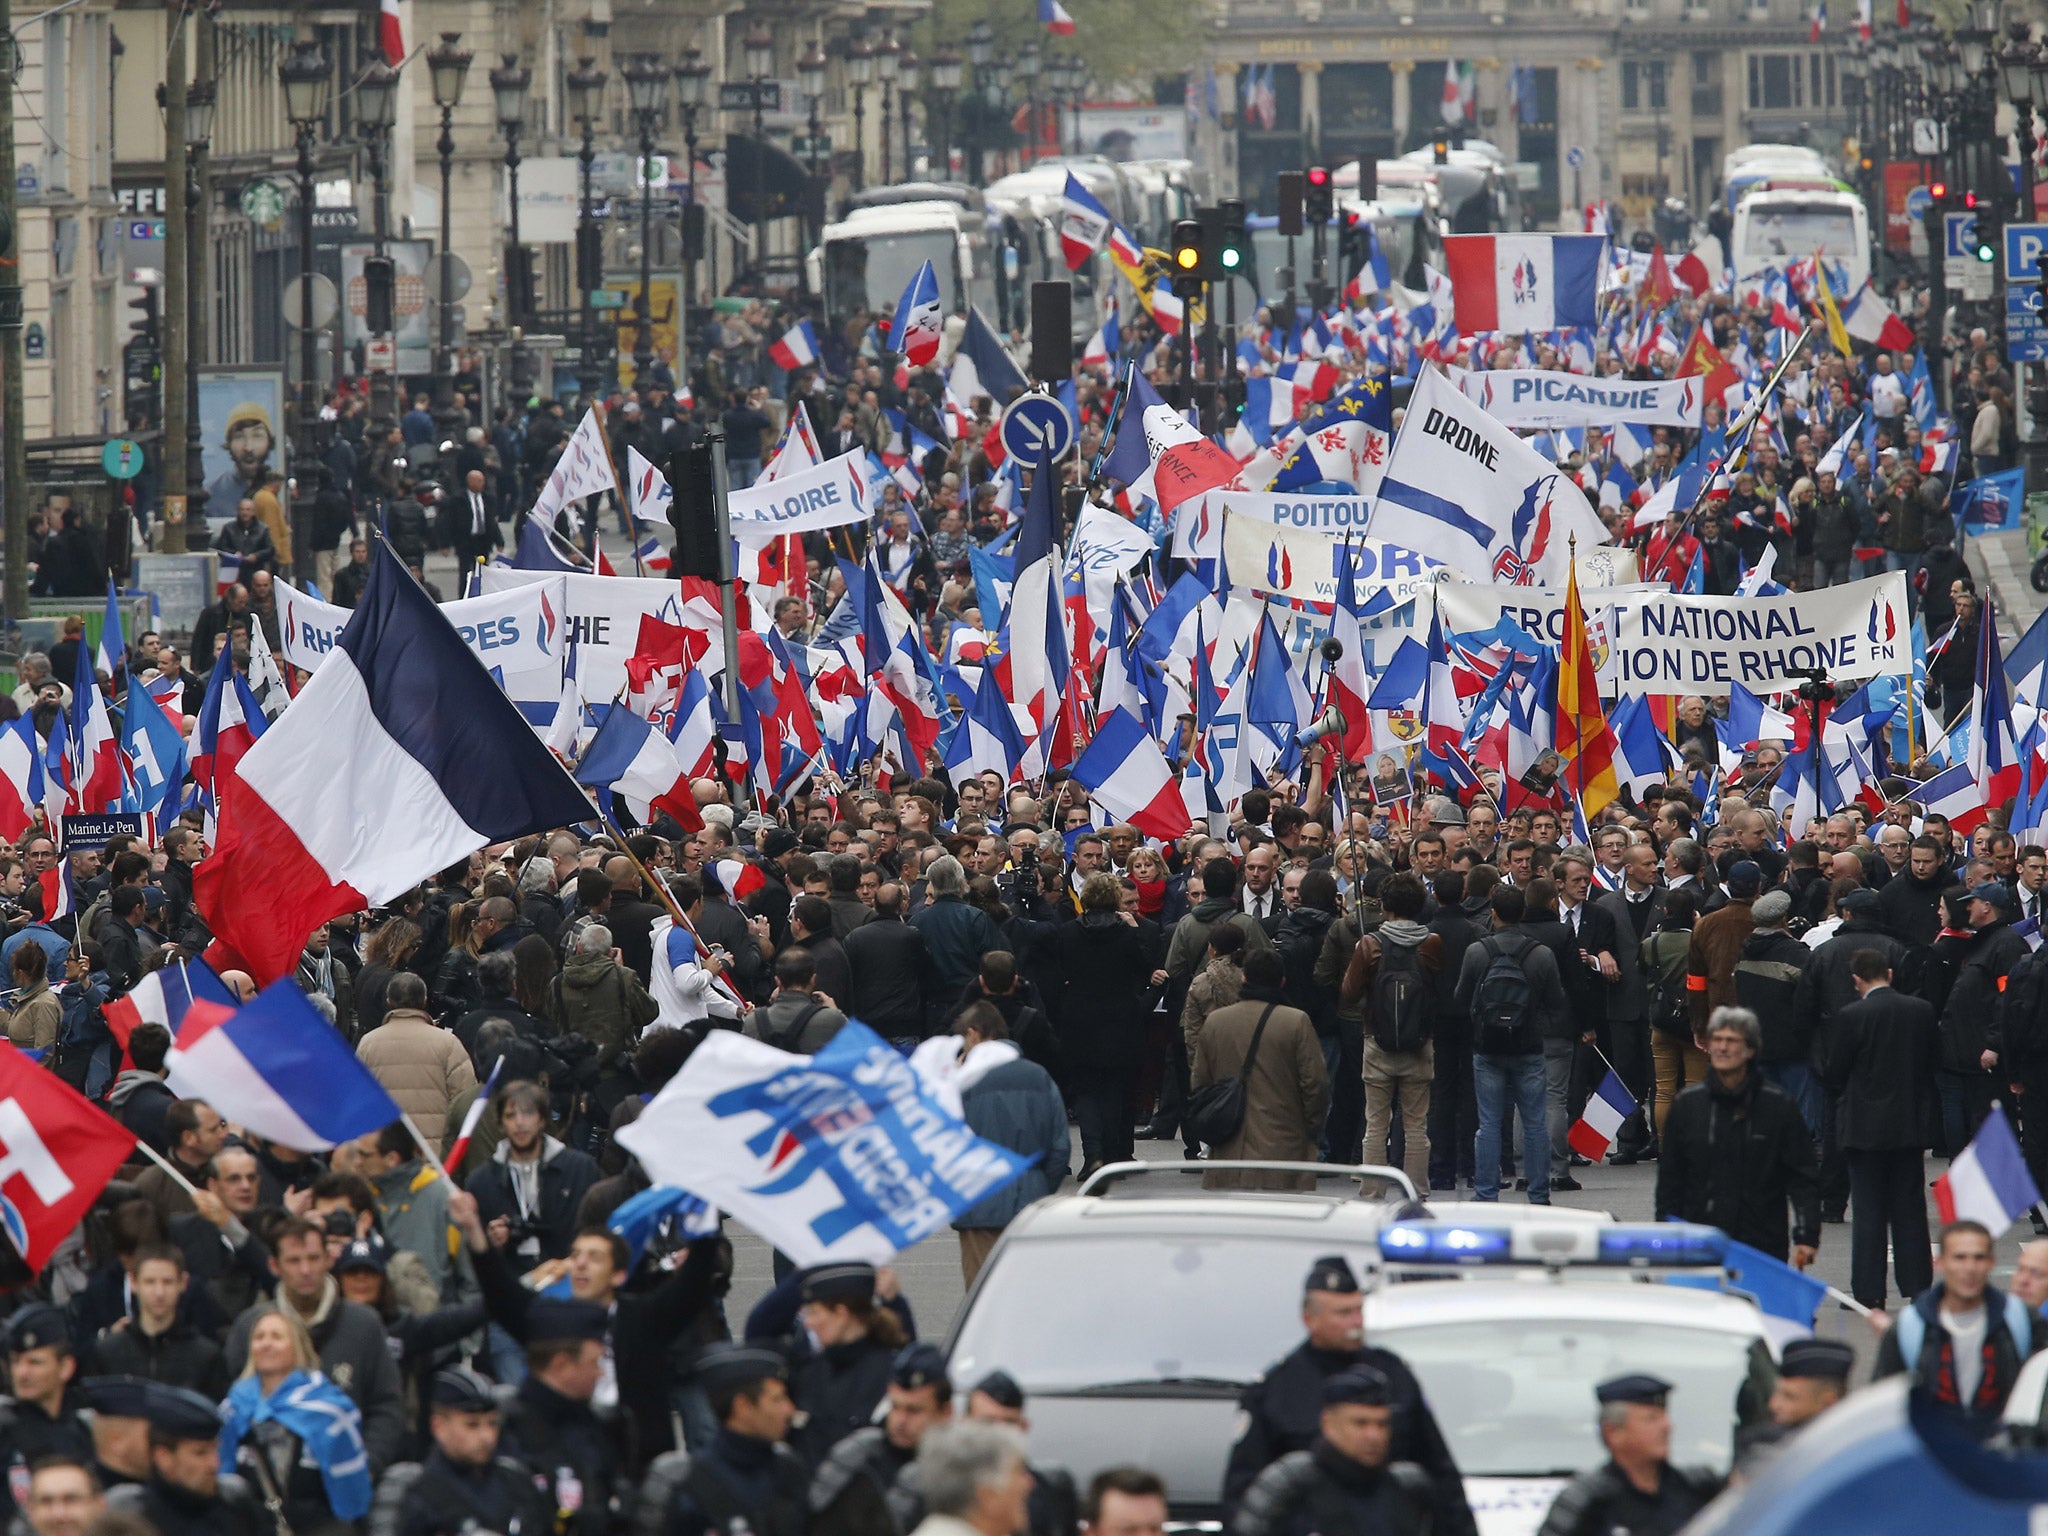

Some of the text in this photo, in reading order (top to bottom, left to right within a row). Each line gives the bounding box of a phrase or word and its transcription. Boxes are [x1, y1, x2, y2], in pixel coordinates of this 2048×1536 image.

[2019, 235, 2042, 270] P
[1513, 378, 1659, 409] PICARDIE
[1423, 407, 1500, 473] DROME
[770, 482, 841, 521] LOIRE
[1274, 502, 1369, 526] POITOU
[463, 616, 520, 651] PES
[1501, 604, 1815, 641] ROT NATIONAL
[1617, 634, 1857, 682] ION DE RHONE
[1870, 644, 1895, 661] FN
[68, 821, 135, 836] Marine Le Pen
